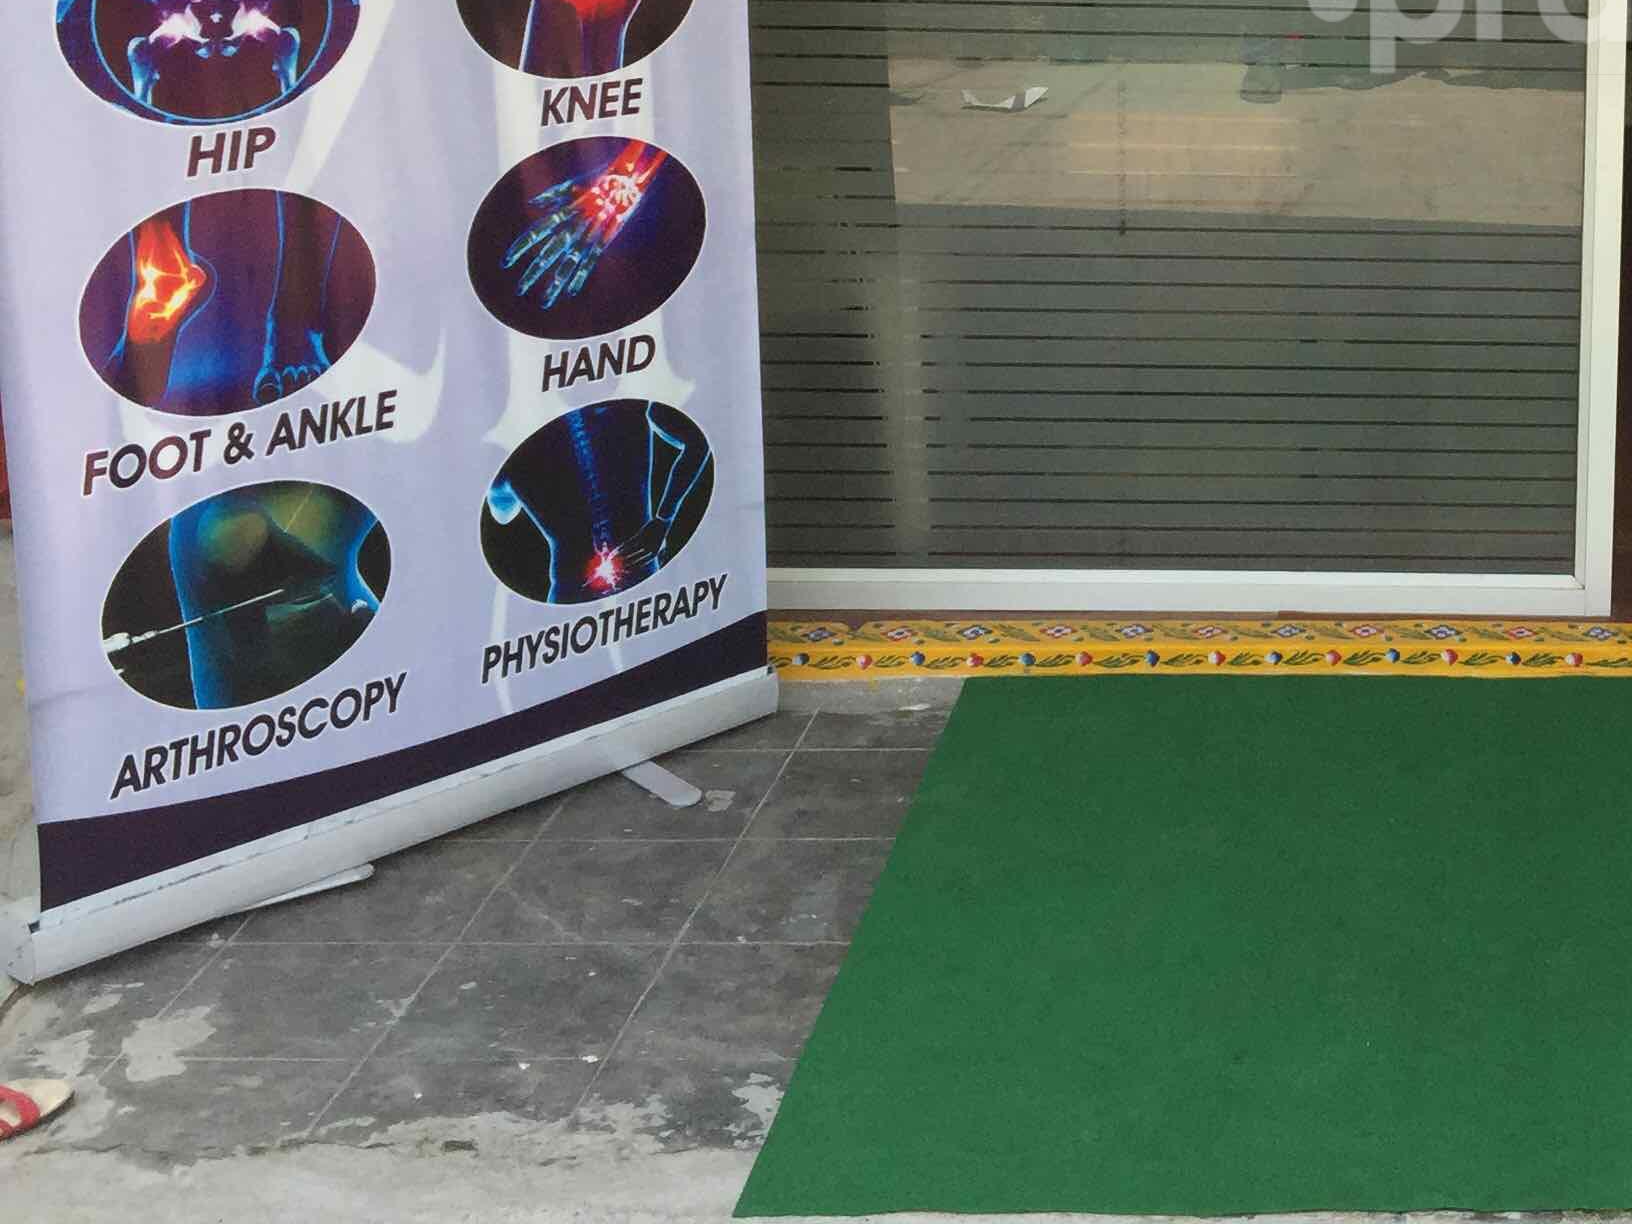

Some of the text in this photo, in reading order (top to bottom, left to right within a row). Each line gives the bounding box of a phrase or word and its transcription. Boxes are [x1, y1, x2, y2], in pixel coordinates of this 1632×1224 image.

[540, 79, 643, 126] KNEE
[186, 127, 275, 177] HIP
[541, 335, 656, 391] HAND
[82, 390, 398, 496] FOOT & ANKLE
[481, 575, 727, 683] PHYSIOTHERAPY
[110, 673, 406, 798] ARTHROSCOPY
